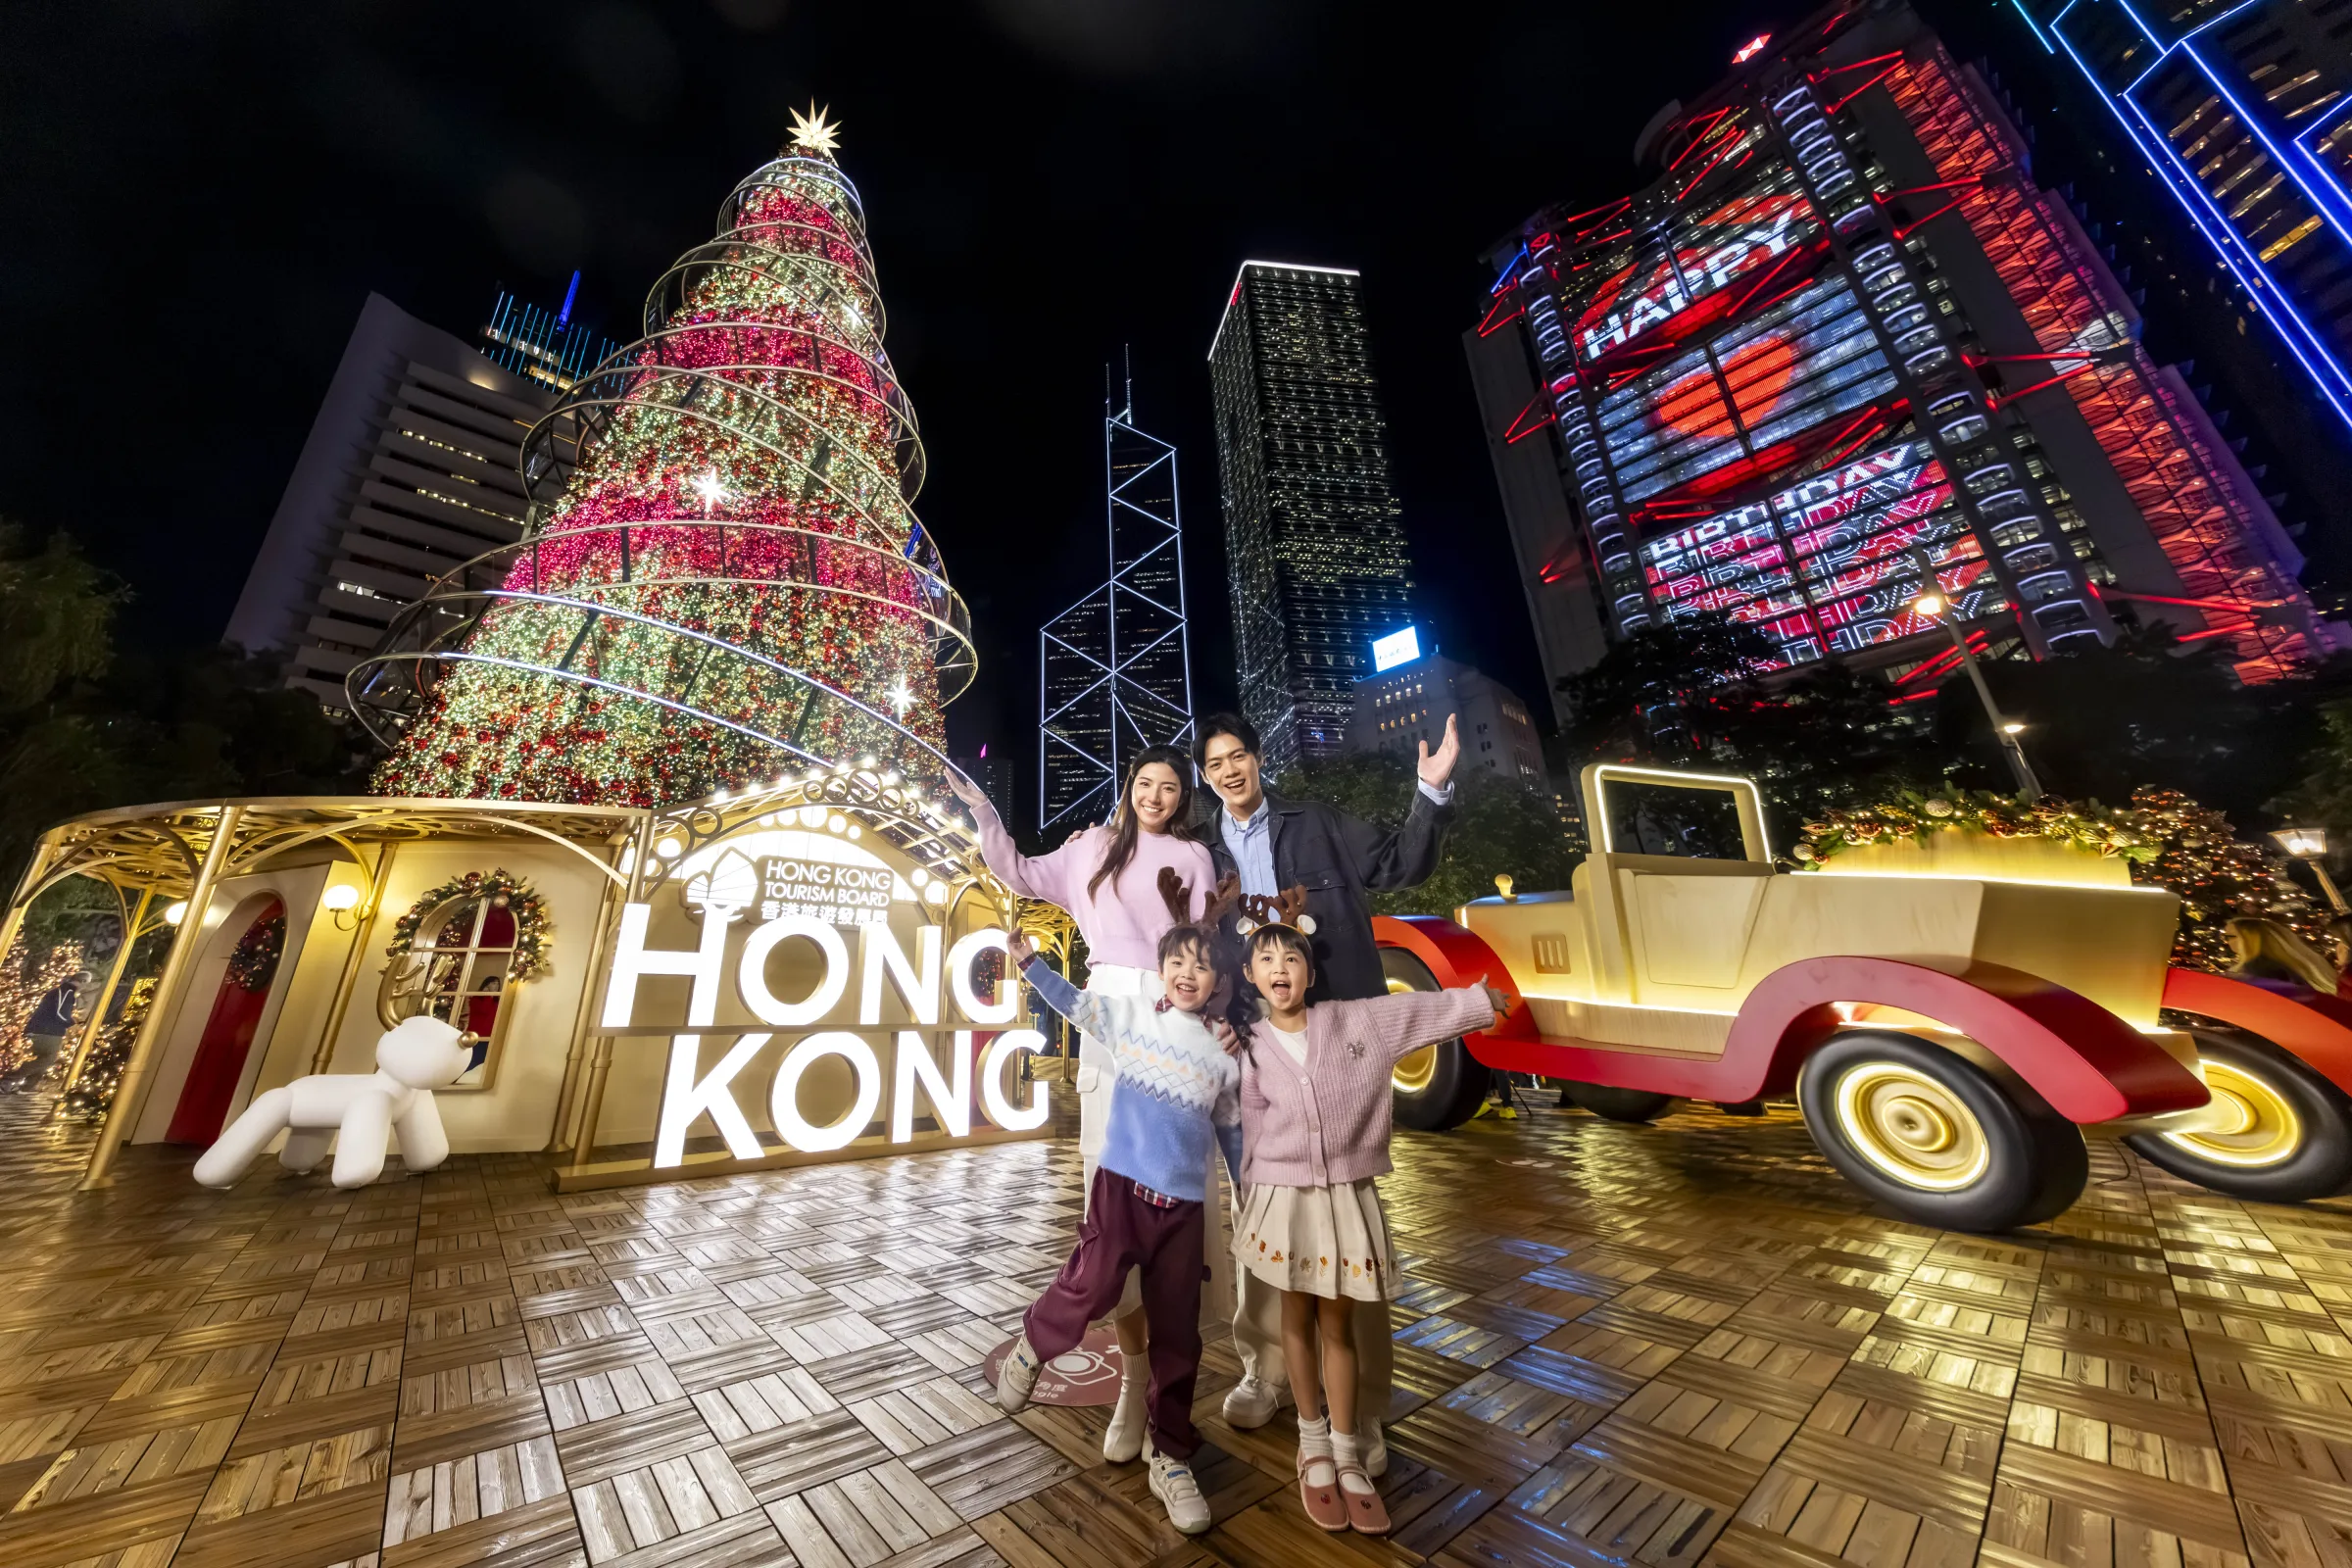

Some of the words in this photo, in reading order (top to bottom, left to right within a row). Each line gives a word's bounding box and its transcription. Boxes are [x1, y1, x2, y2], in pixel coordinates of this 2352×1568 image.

[1584, 210, 1793, 360] HAPPY
[1650, 445, 1911, 566] BIRTHDAY
[764, 881, 834, 903] TOURISM
[837, 888, 889, 907] BOARD
[765, 859, 831, 884] HONG
[834, 866, 891, 890] KONG
[602, 903, 1019, 1027] HONG
[654, 1029, 1050, 1169] KONG
[1033, 1391, 1059, 1399] ngle
[1035, 1380, 1068, 1393] 角度
